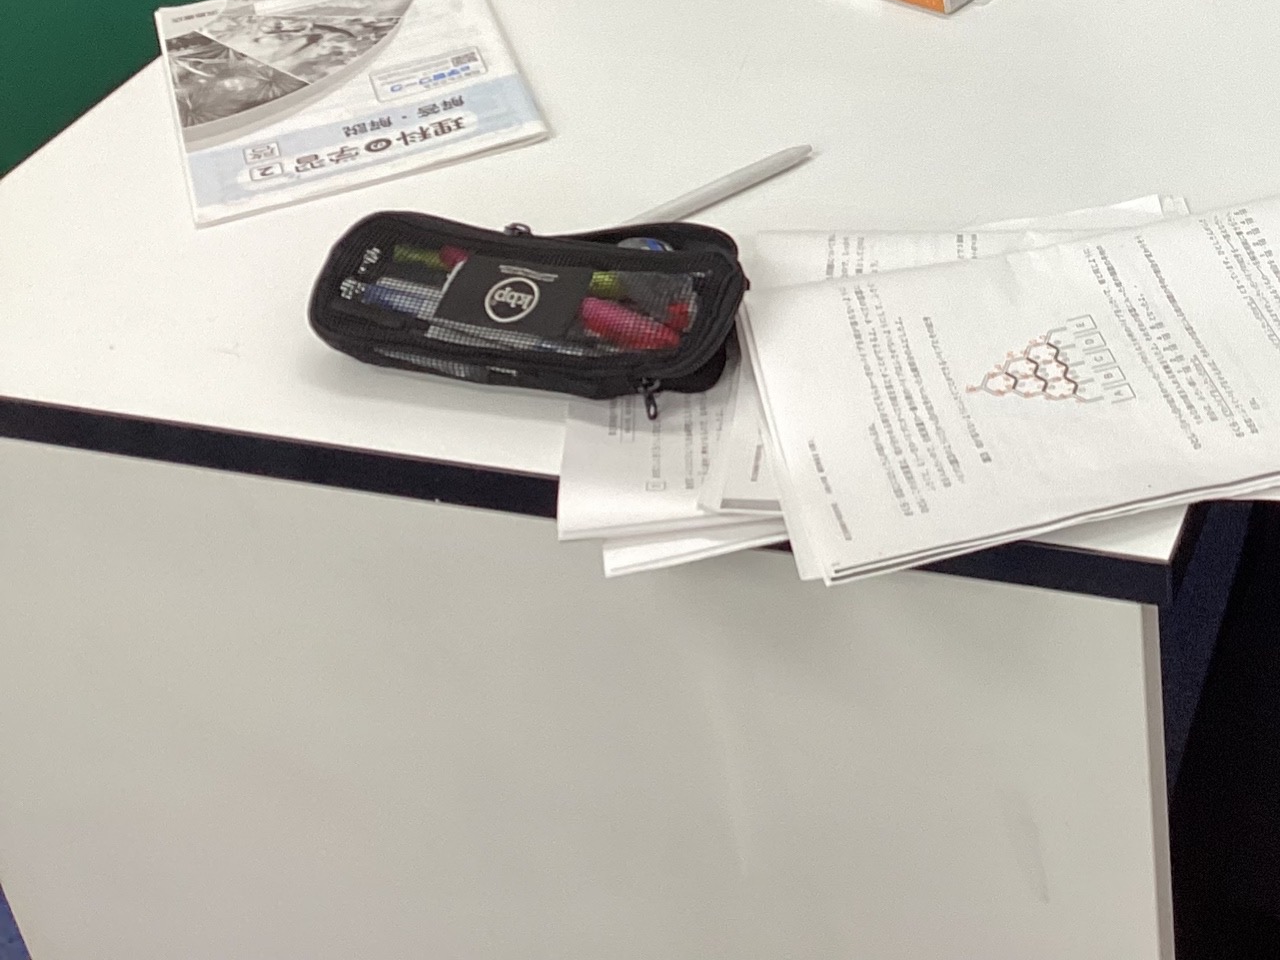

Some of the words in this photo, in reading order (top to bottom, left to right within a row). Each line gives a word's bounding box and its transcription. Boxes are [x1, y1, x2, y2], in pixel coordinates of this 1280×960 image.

[295, 116, 466, 173] 理科の学習
